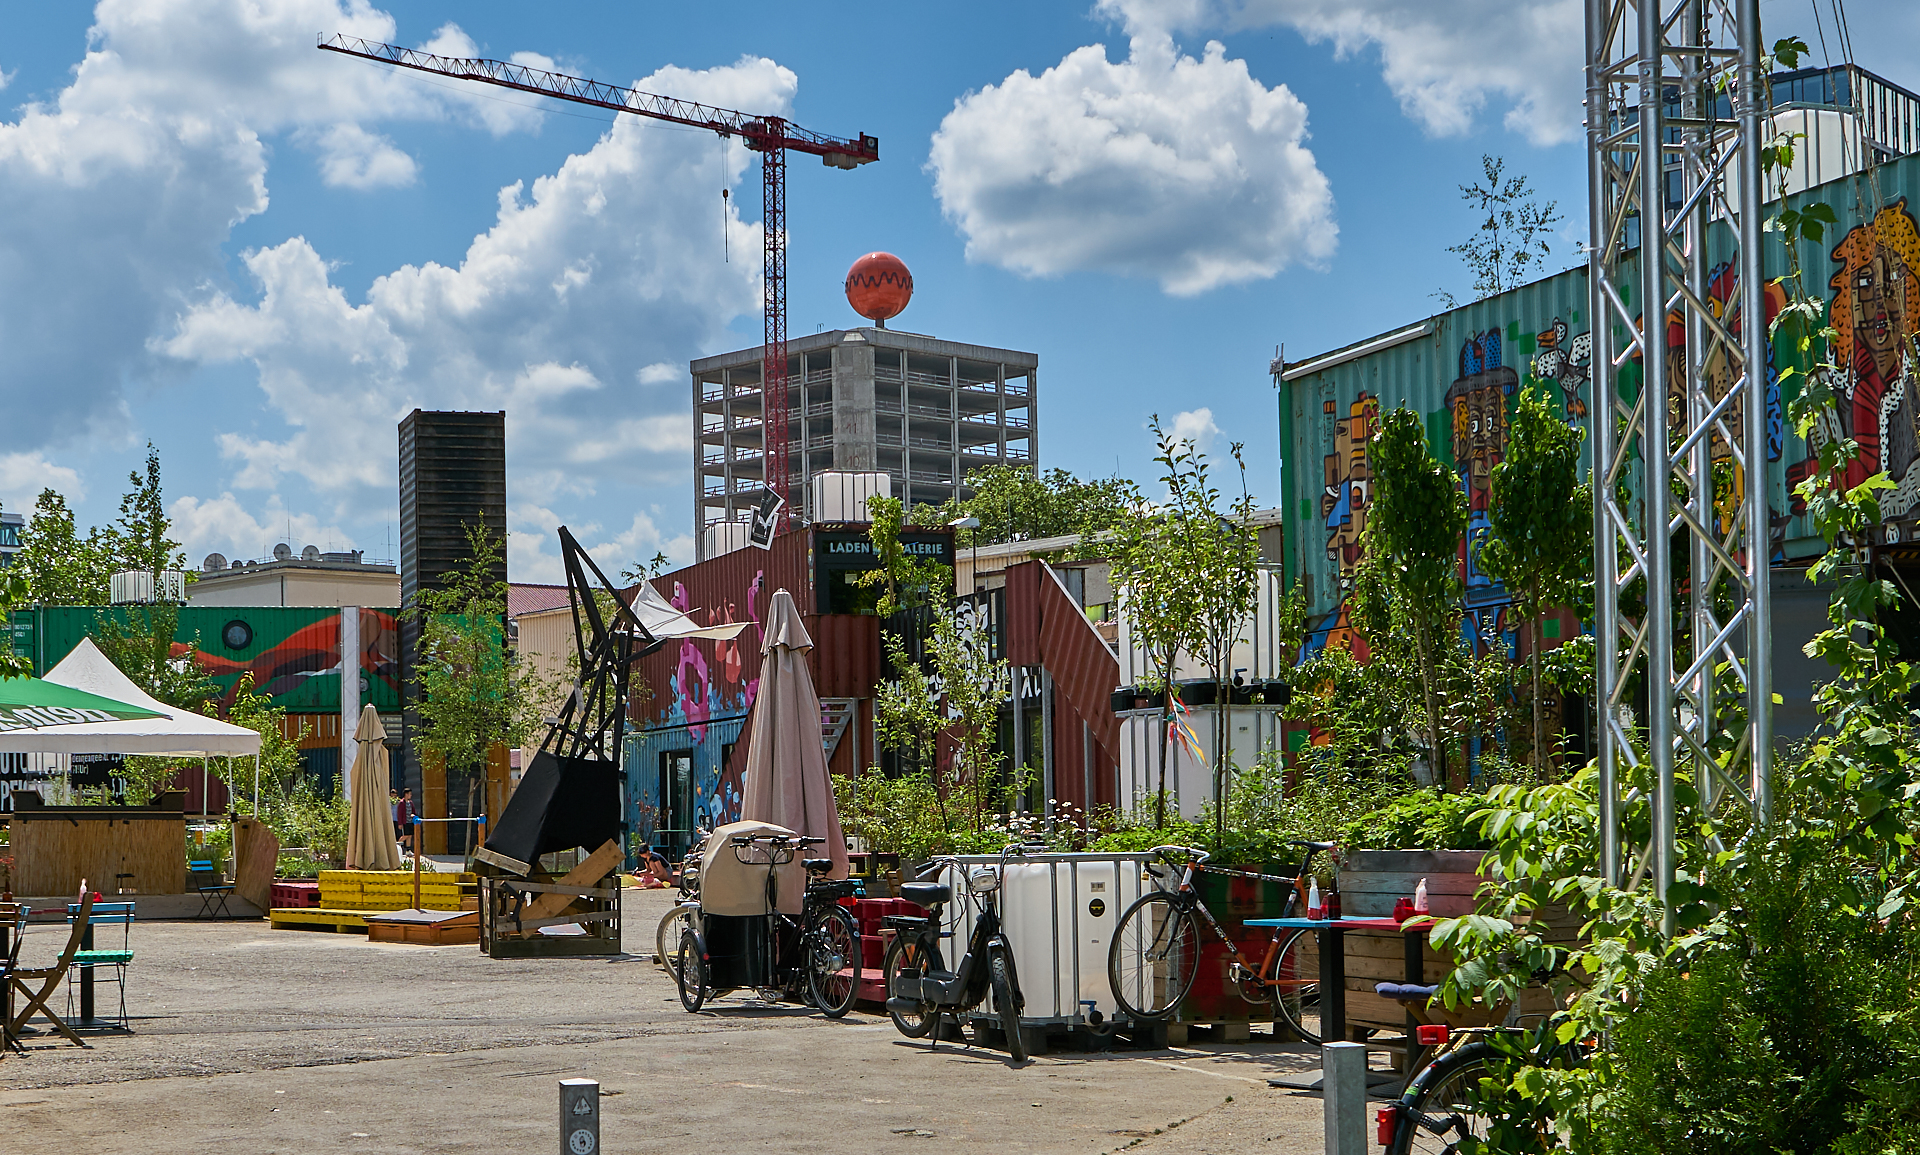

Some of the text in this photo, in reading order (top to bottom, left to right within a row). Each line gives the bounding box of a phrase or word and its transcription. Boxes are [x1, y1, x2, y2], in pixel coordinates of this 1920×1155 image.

[846, 455, 860, 467] 10
[829, 542, 870, 554] LADEN
[902, 543, 944, 555] ALERIE
